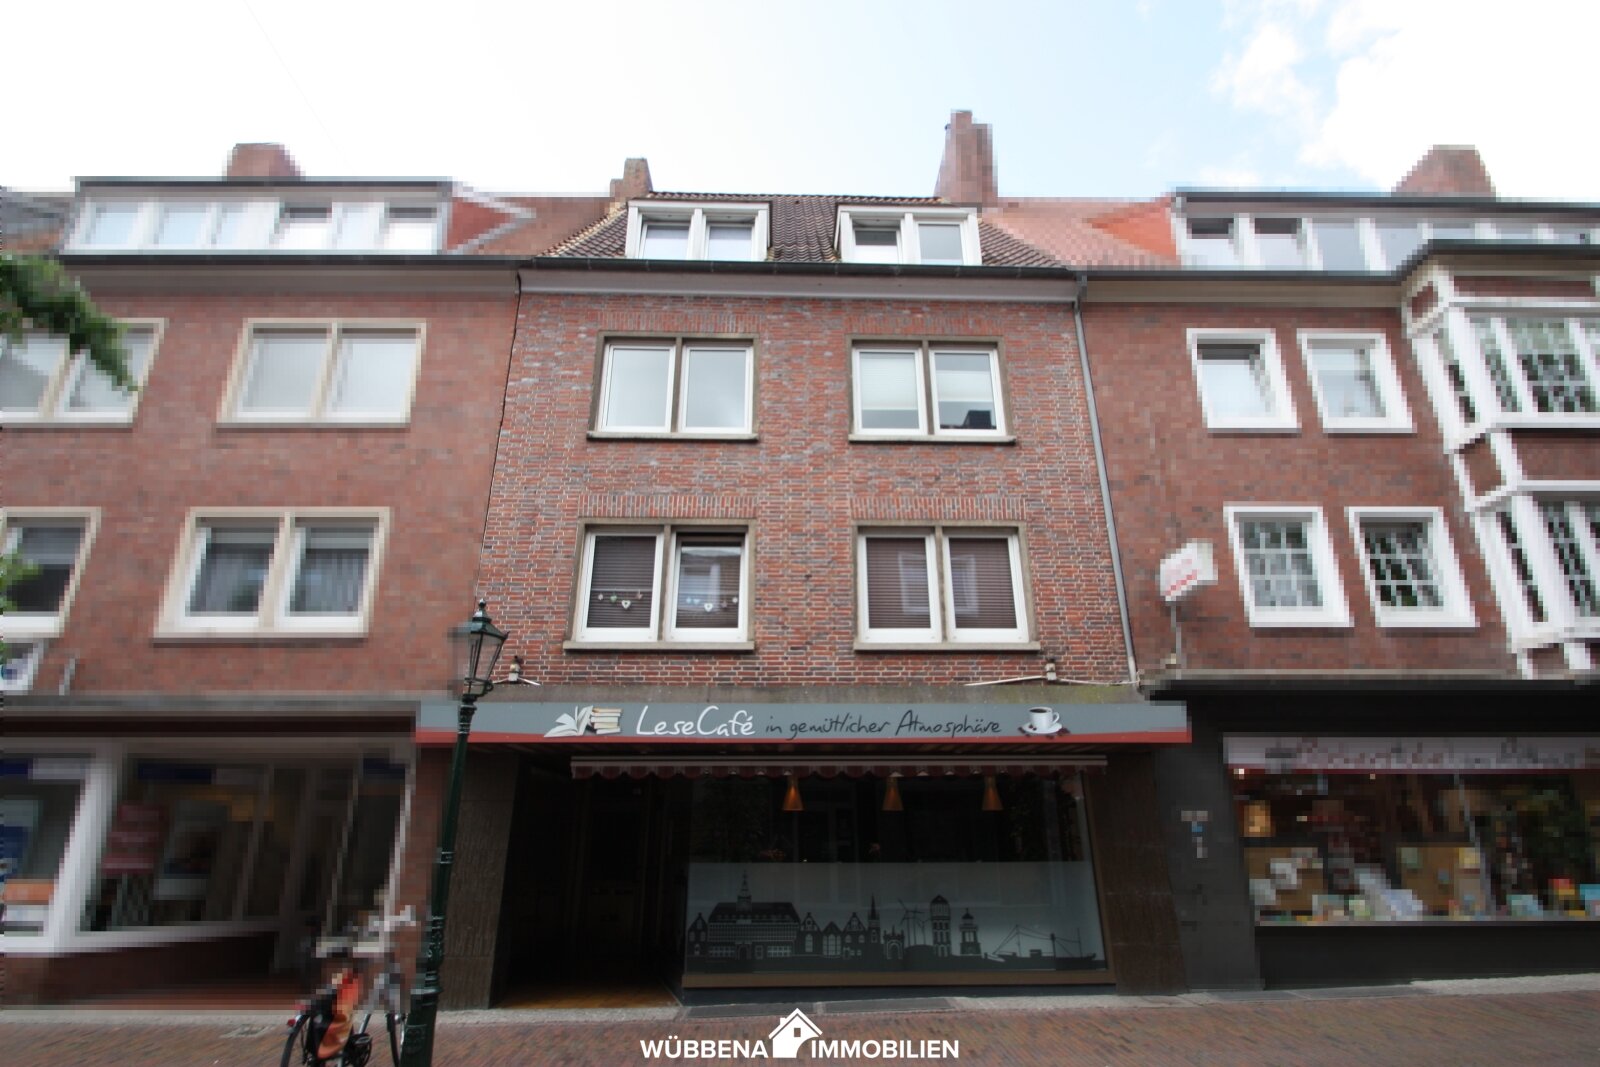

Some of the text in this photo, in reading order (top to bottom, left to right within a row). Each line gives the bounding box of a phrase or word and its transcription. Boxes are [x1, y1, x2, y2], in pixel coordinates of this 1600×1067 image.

[636, 705, 1001, 740] LeseCafé in gemütlicher Atmosphäre
